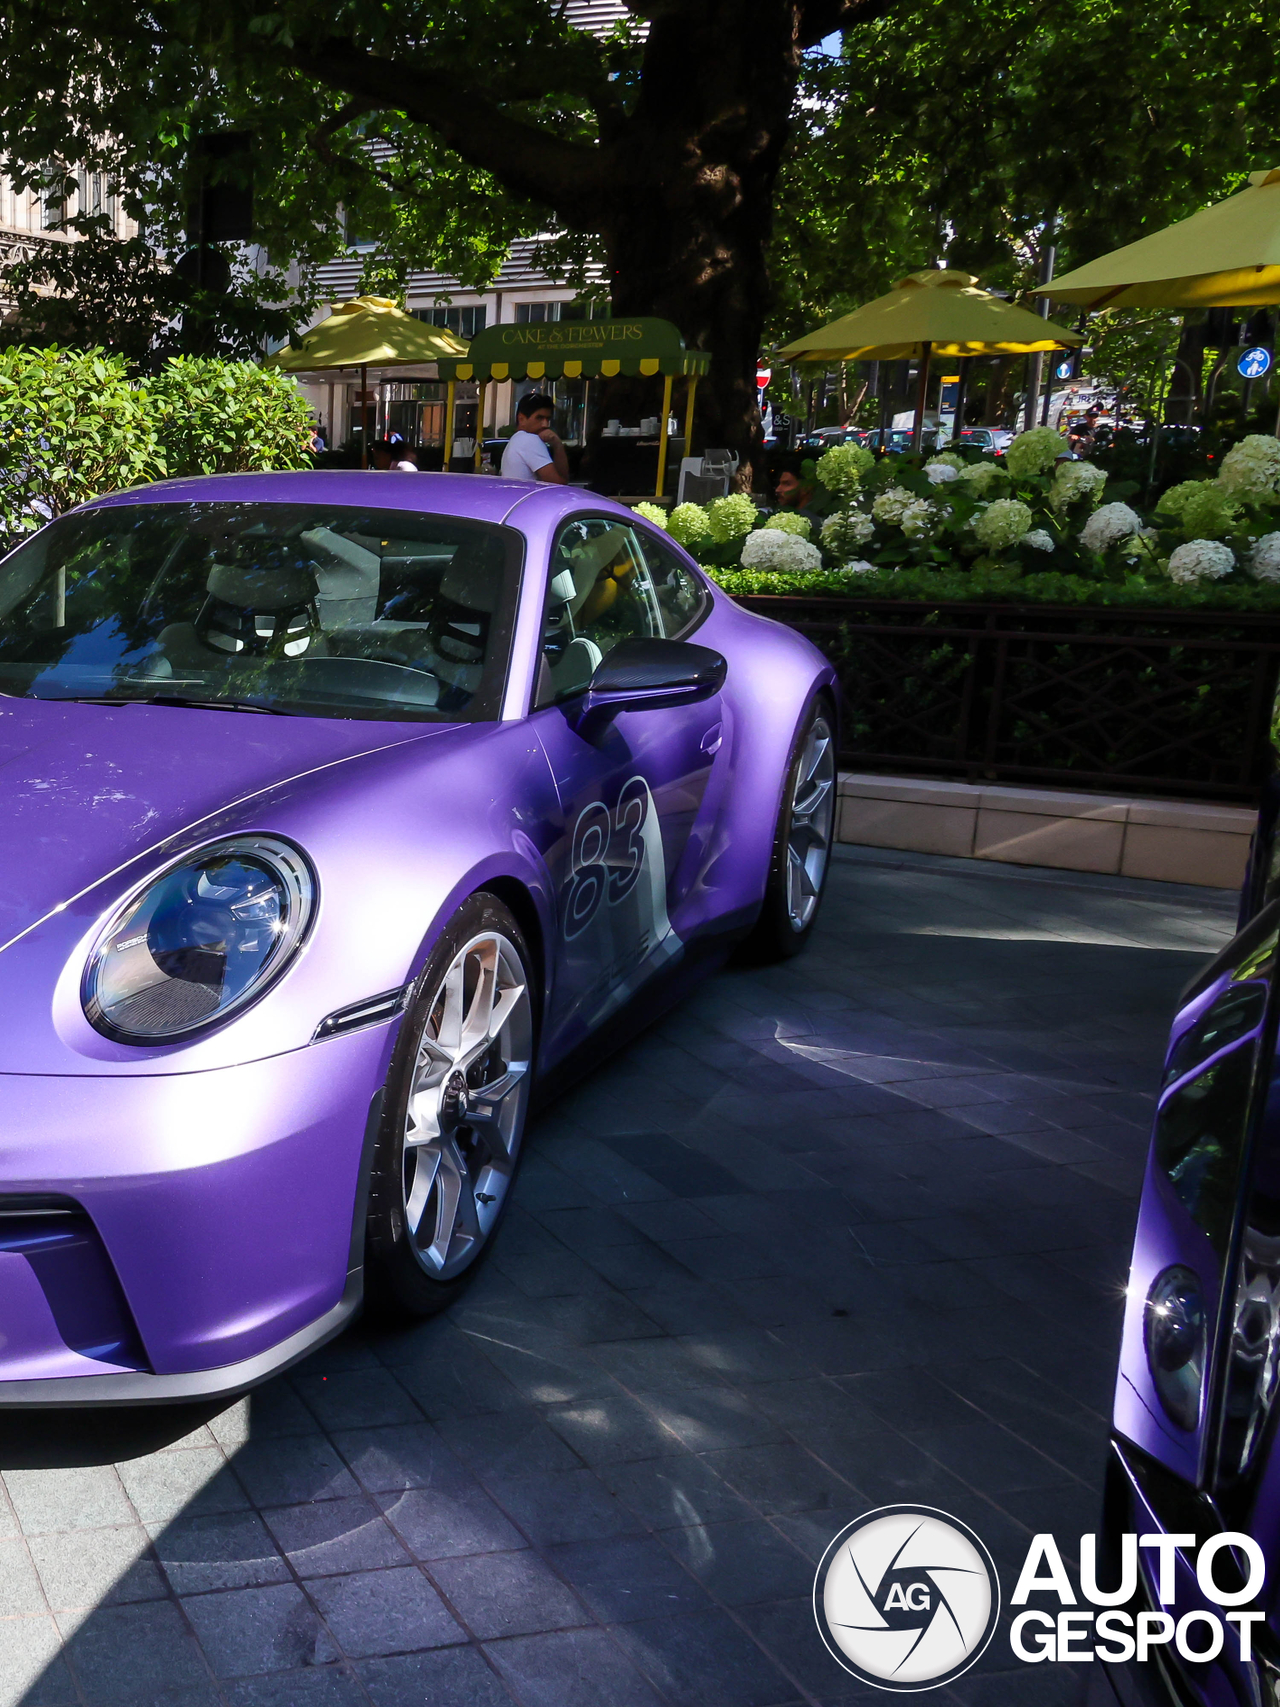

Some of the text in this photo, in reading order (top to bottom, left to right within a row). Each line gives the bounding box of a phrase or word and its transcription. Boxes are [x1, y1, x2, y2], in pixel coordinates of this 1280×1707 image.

[502, 324, 643, 345] CAKE & FLOWERS
[564, 775, 650, 941] 83
